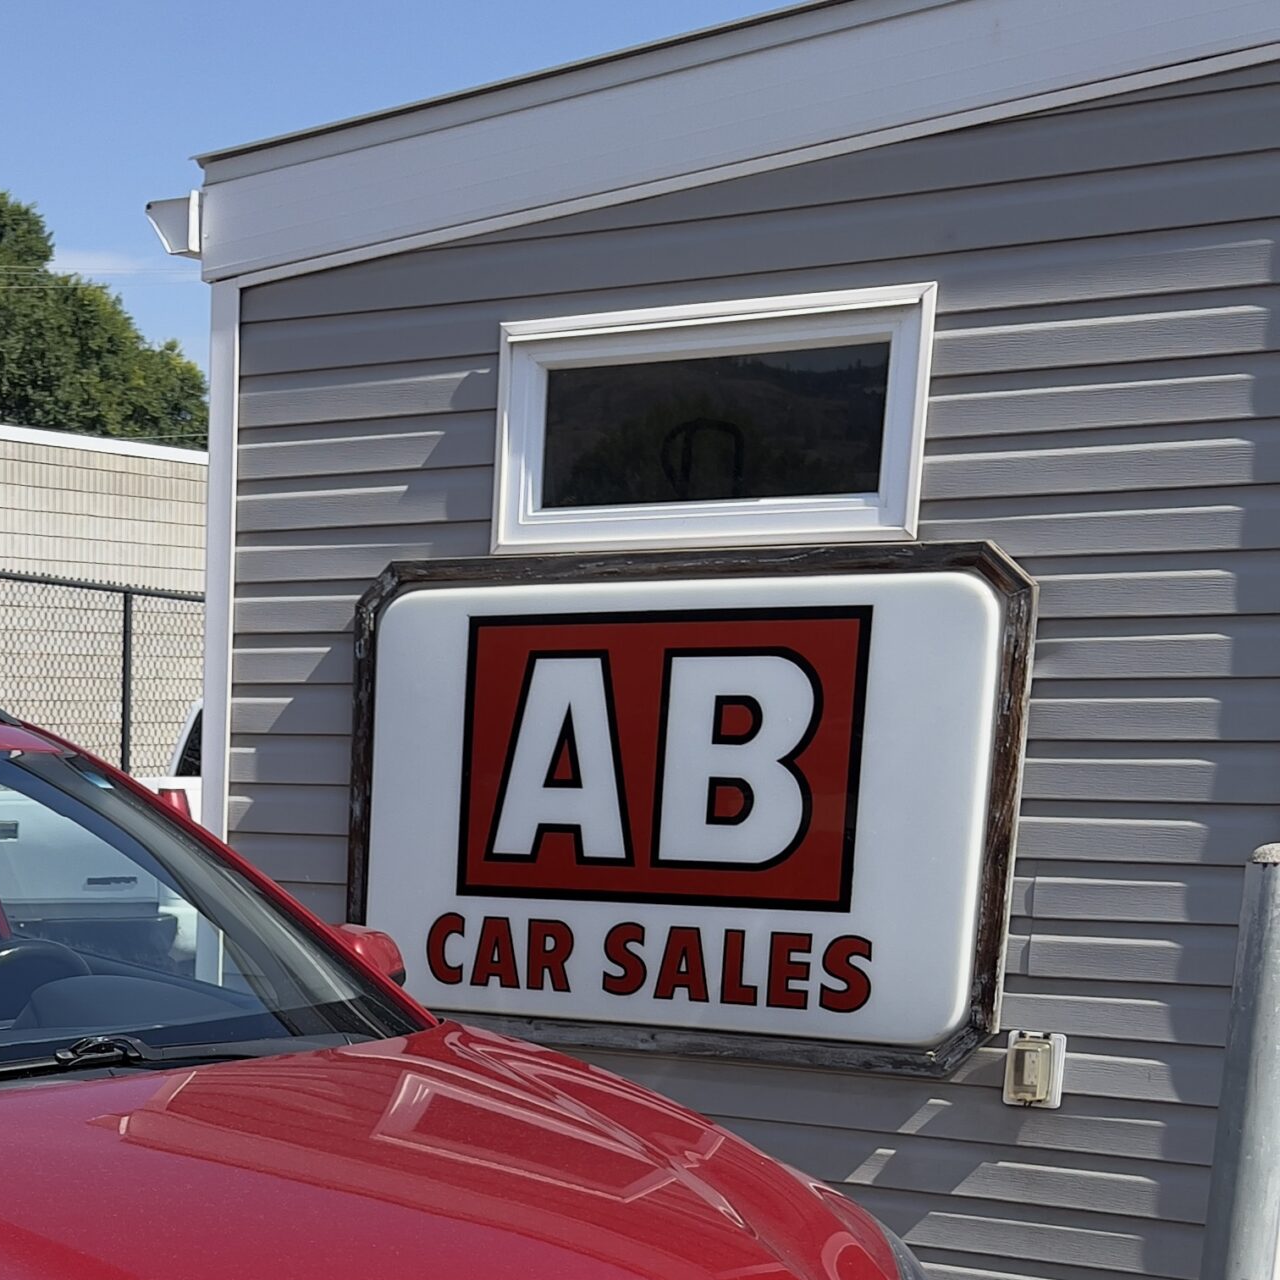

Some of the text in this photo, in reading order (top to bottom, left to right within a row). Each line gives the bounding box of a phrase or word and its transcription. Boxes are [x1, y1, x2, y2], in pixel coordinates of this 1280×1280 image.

[484, 646, 824, 871] AB
[426, 912, 874, 1013] CAR SALES
